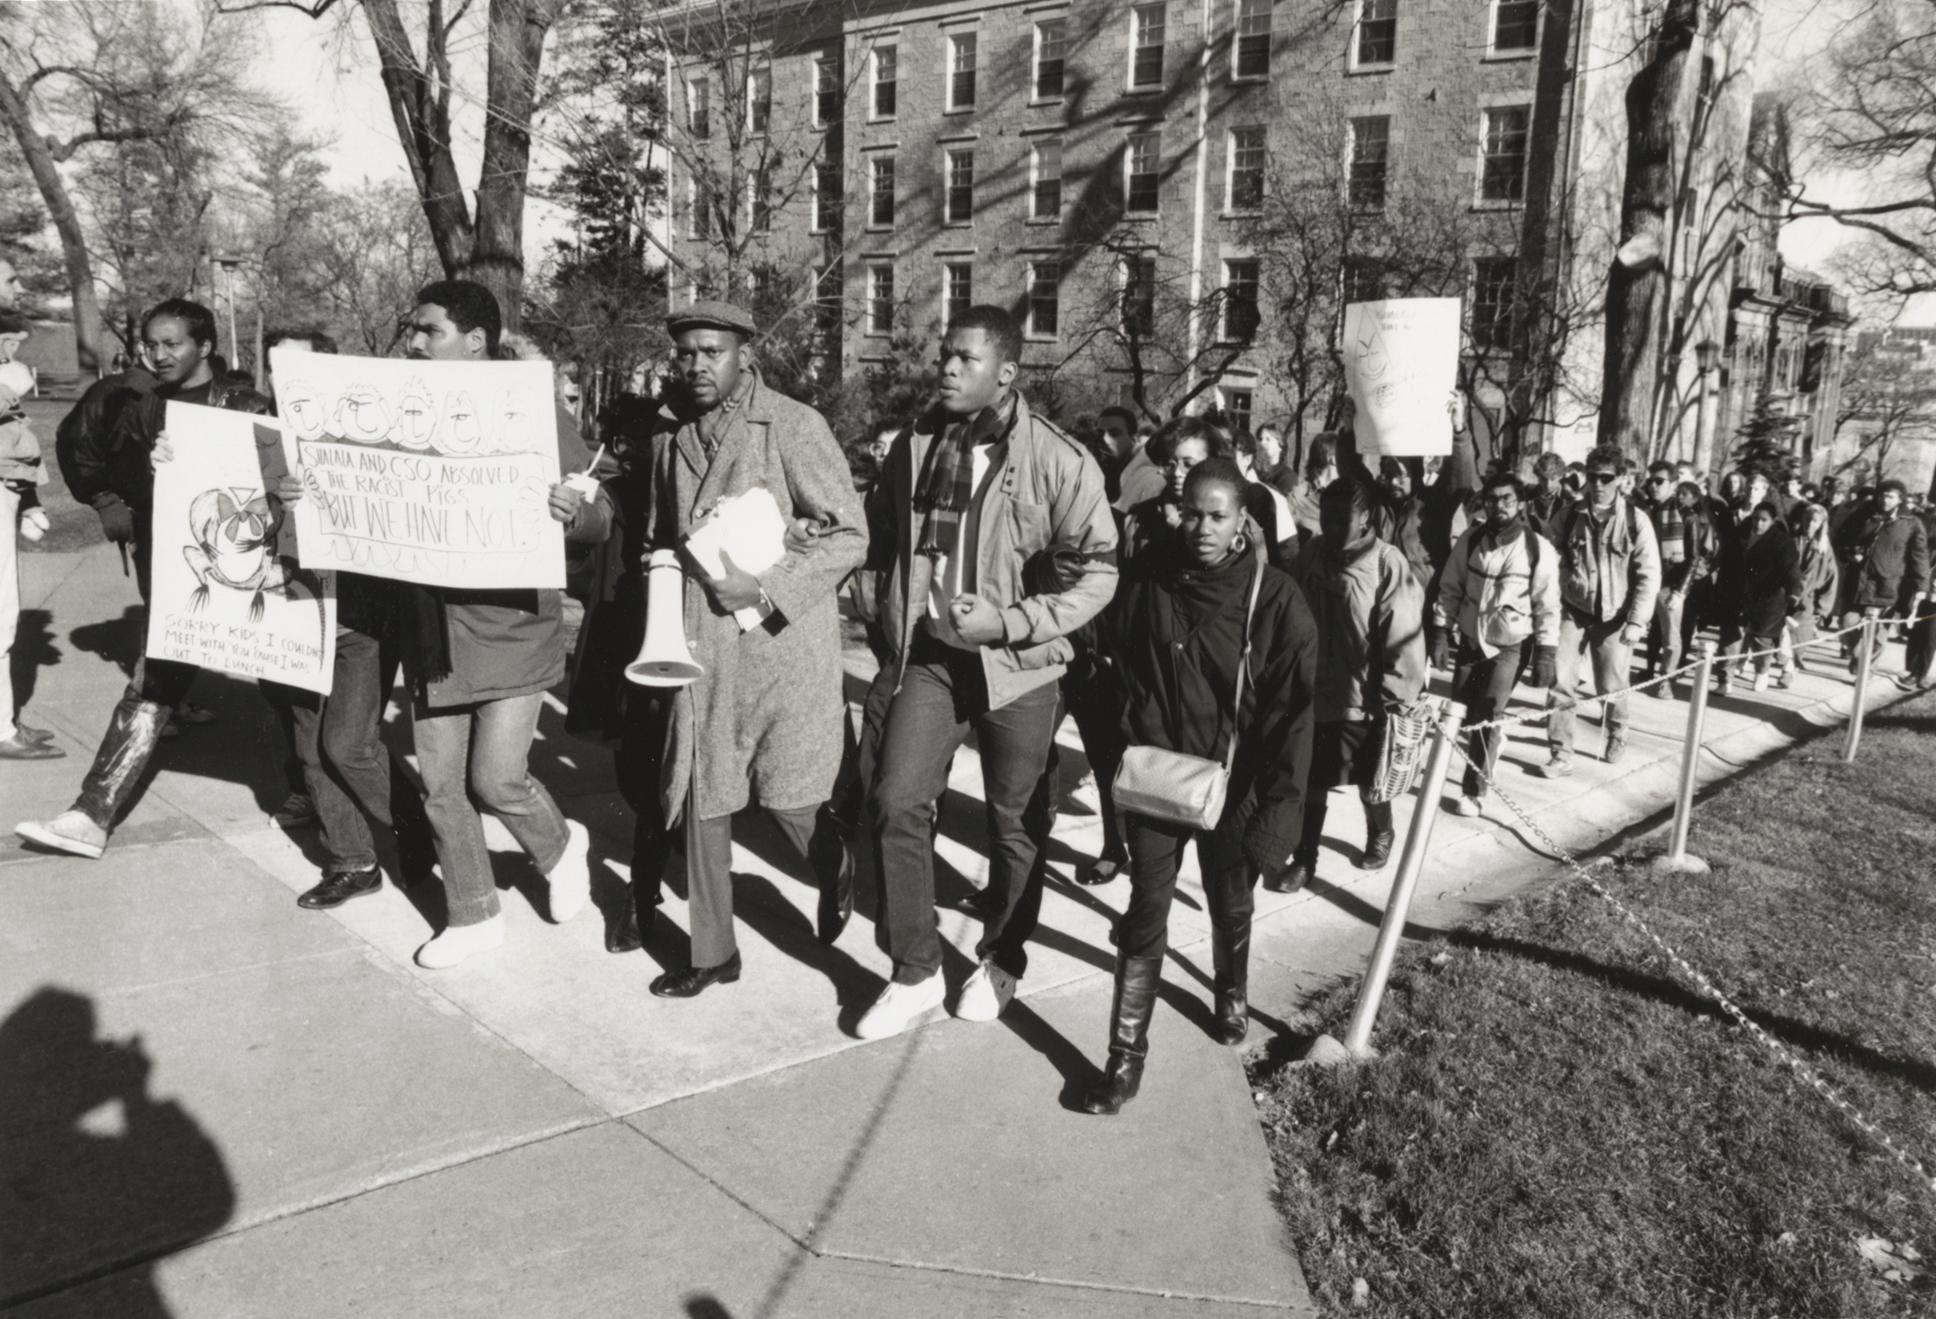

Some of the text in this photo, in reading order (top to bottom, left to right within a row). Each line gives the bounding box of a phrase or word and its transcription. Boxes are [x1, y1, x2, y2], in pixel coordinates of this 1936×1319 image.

[321, 470, 349, 490] THE
[360, 452, 386, 475] AND
[390, 456, 431, 482] CSO
[440, 463, 519, 485] ABSOLVED
[322, 490, 357, 530] BUT
[365, 496, 401, 540] WE
[164, 613, 221, 636] SORRY
[267, 632, 274, 648] I
[163, 646, 191, 660] OUT
[224, 657, 264, 676] LUNCH
[165, 629, 195, 647] MEET
[200, 638, 225, 653] WITH
[232, 643, 250, 658] YOU
[280, 654, 287, 670] I
